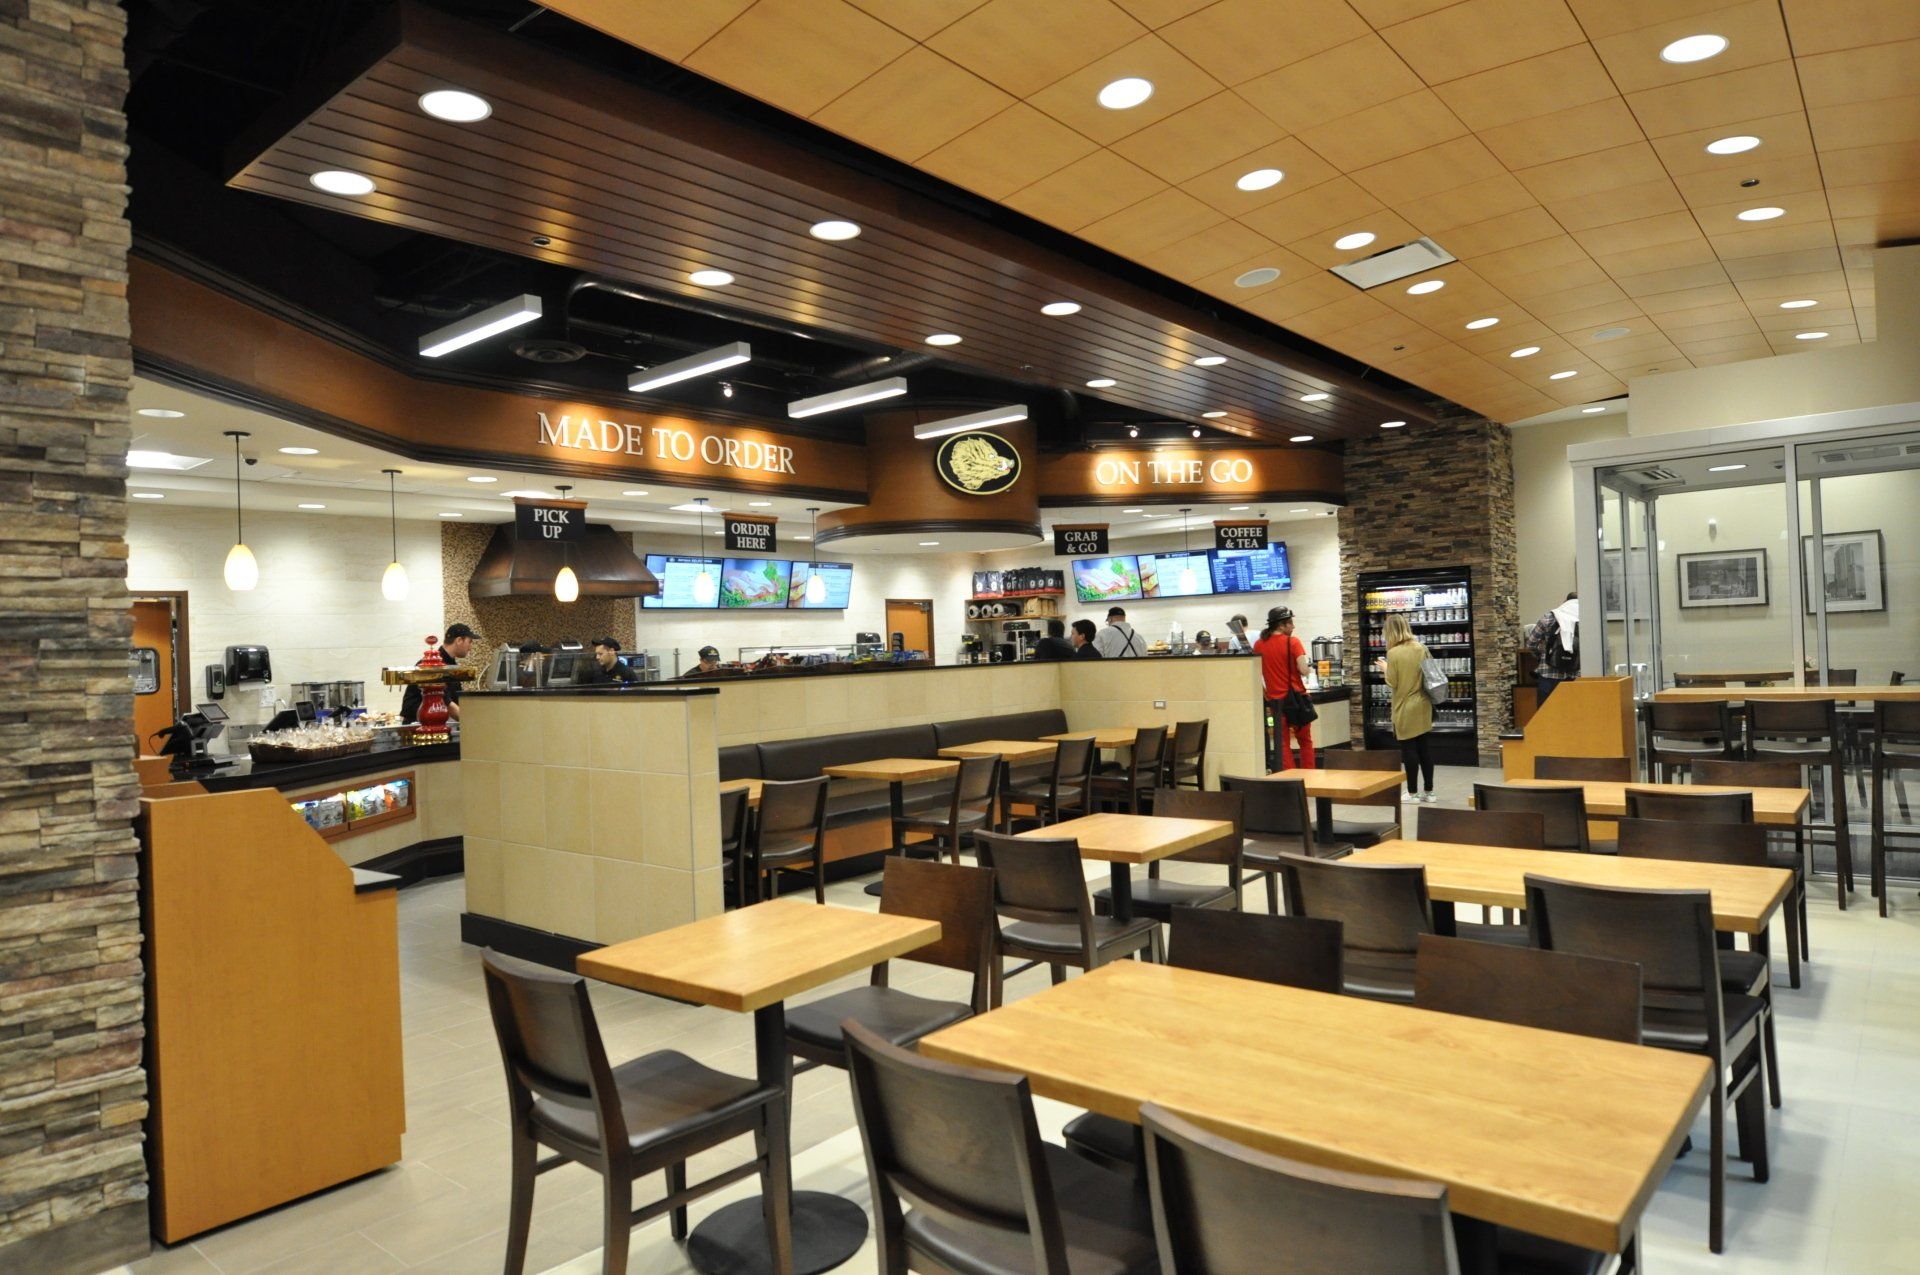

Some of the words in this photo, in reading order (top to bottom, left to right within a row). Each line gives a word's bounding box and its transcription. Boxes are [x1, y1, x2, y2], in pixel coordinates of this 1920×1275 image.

[536, 411, 644, 456] MADE
[651, 427, 695, 461] TO
[700, 435, 796, 474] ORDER
[1095, 460, 1141, 485] ON
[1147, 460, 1204, 484] THE
[1209, 459, 1253, 483] GO
[533, 508, 570, 524] PICK
[542, 524, 562, 539] UP
[731, 522, 771, 536] ORDER
[1220, 527, 1263, 538] COFFEE
[736, 536, 766, 549] HERE
[1064, 531, 1098, 542] GRAB
[1066, 543, 1076, 553] &
[1078, 542, 1097, 553] GO
[1225, 539, 1234, 549] &
[1236, 538, 1259, 548] TEA
